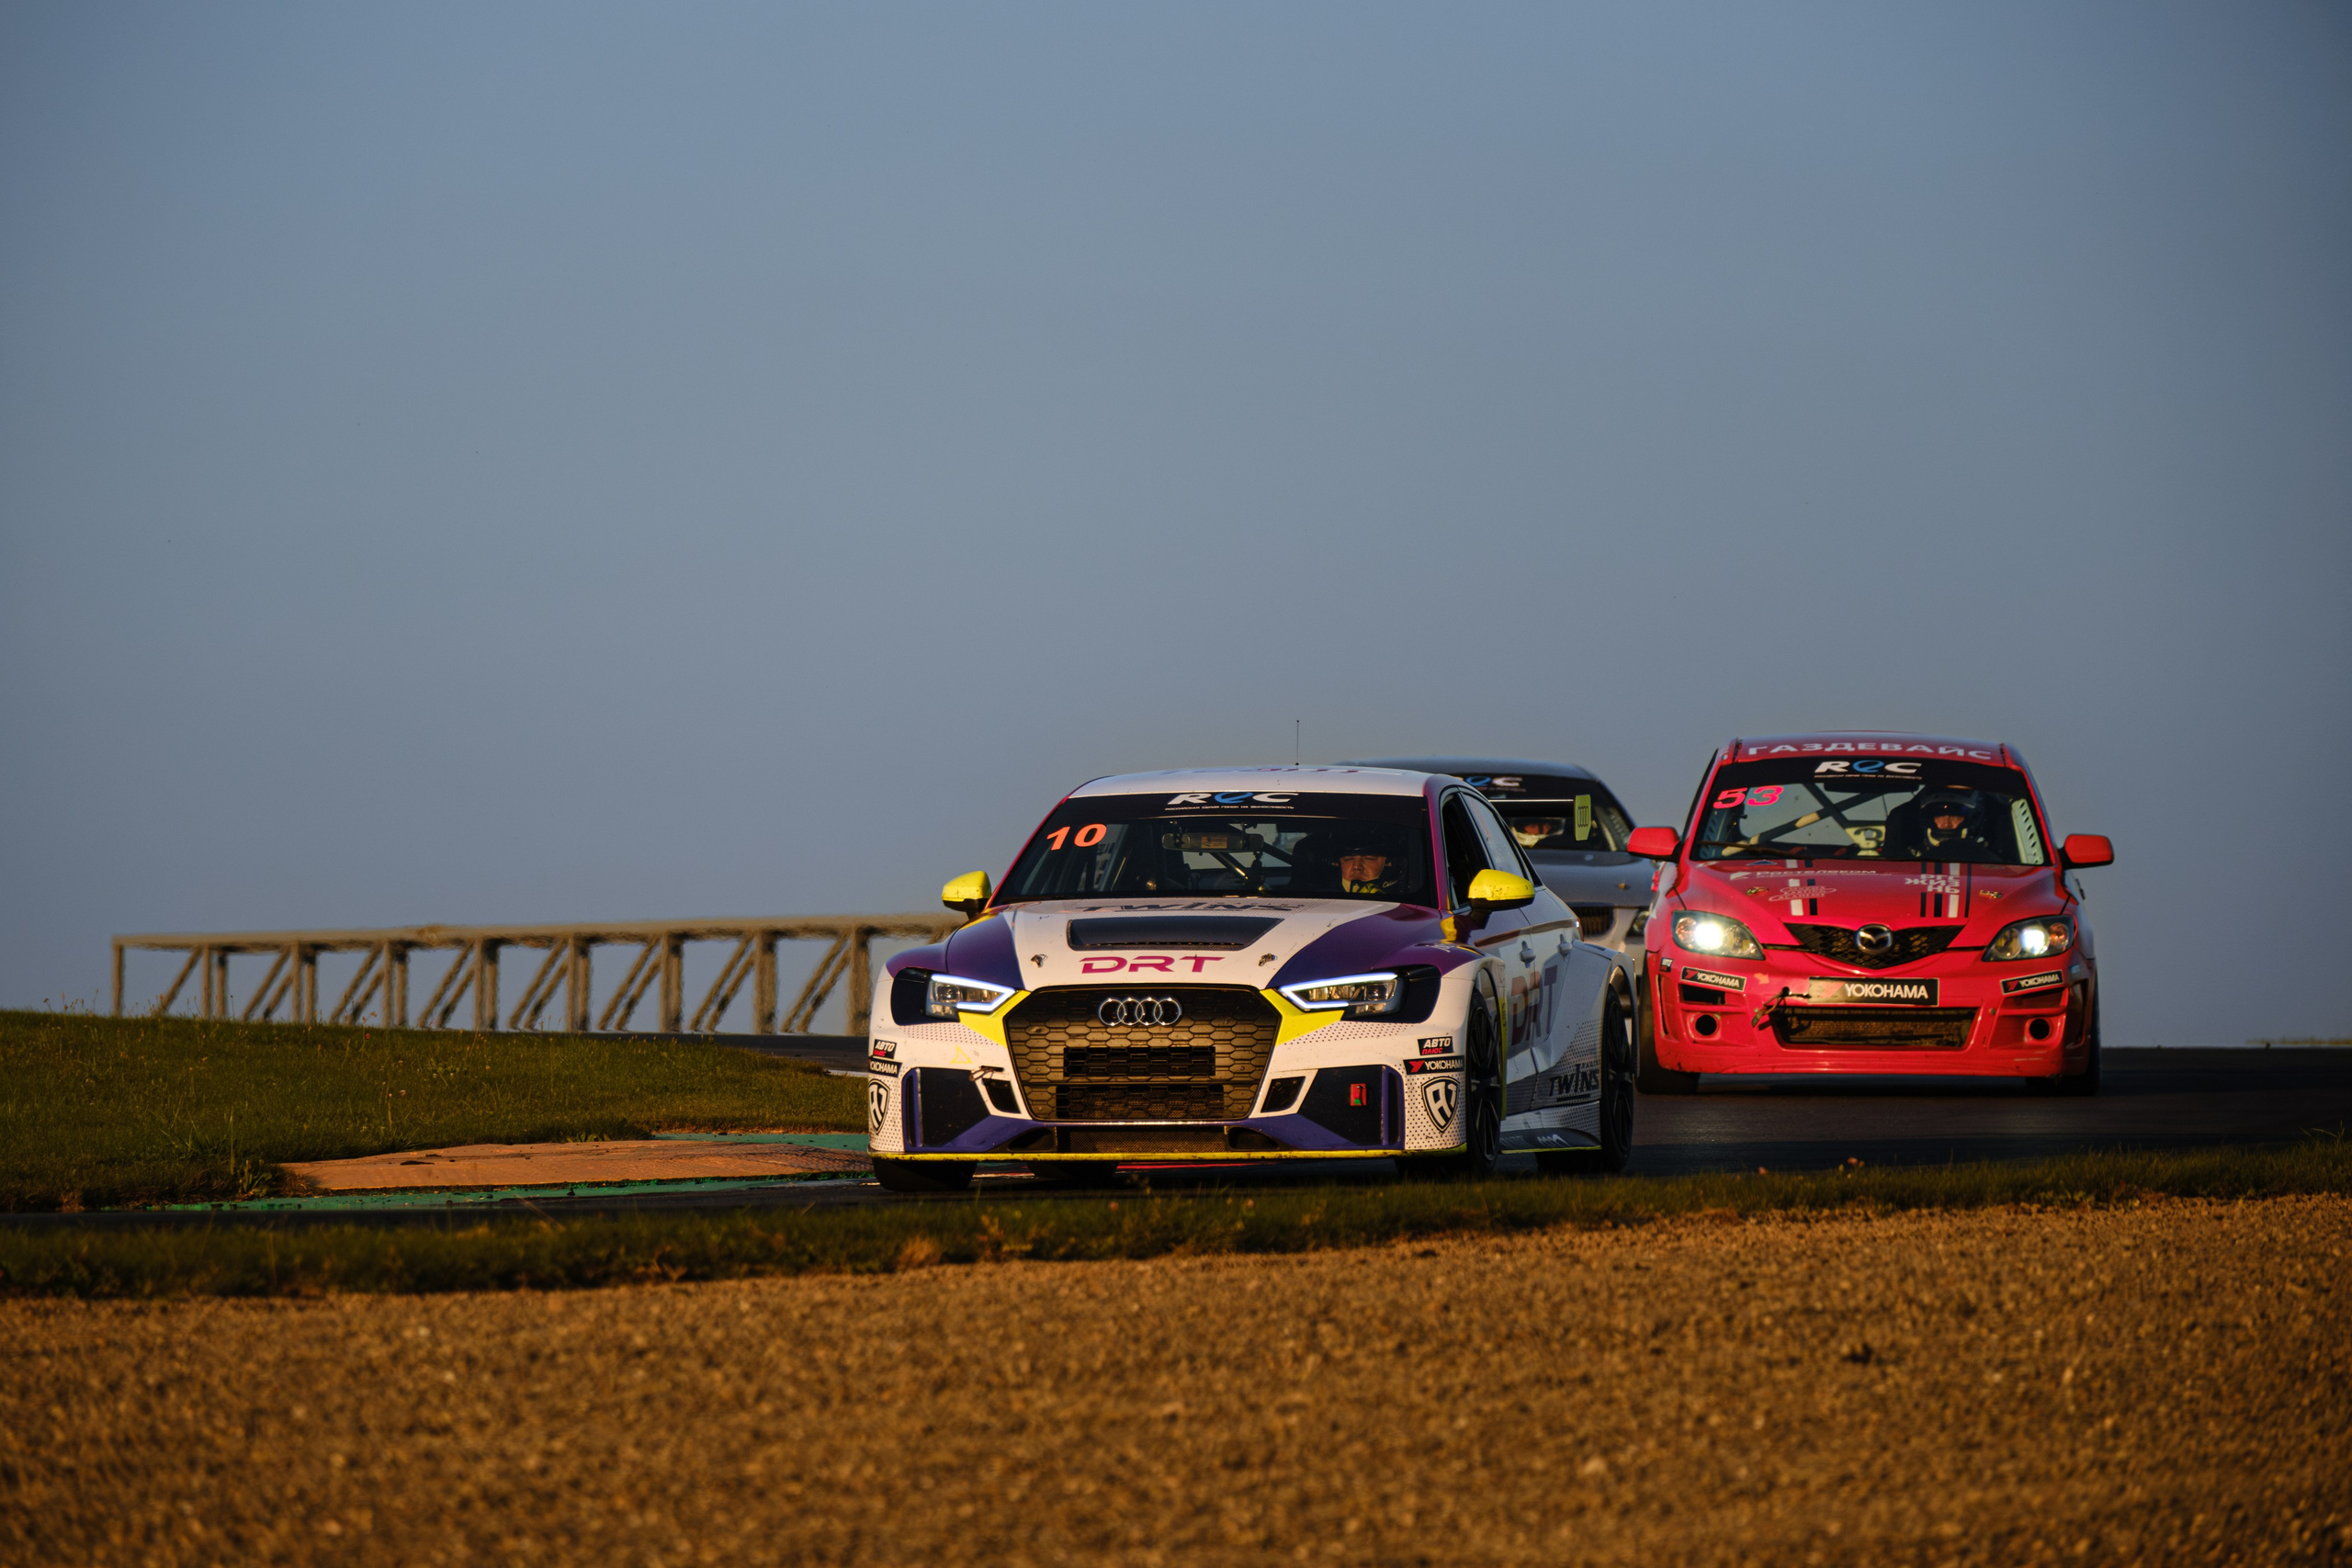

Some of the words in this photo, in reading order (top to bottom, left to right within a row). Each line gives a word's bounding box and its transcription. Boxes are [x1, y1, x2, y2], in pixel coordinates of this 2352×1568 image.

[1747, 742, 1992, 761] ГАЗДЕВАЙС
[1713, 785, 1784, 809] 53
[1046, 823, 1107, 851] 10
[1080, 955, 1225, 974] DRT
[1697, 972, 1740, 987] YOKOHAMA
[2018, 973, 2061, 988] YOKOHAMA
[1845, 983, 1928, 999] YOKOHAMA
[1510, 964, 1558, 1046] DRT
[875, 1041, 896, 1052] АВТО
[1421, 1047, 1443, 1055] ПЛЮС
[1423, 1038, 1452, 1049] АВТО
[1425, 1059, 1464, 1071] YOKOHAMA
[1549, 1064, 1600, 1097] TWINS
